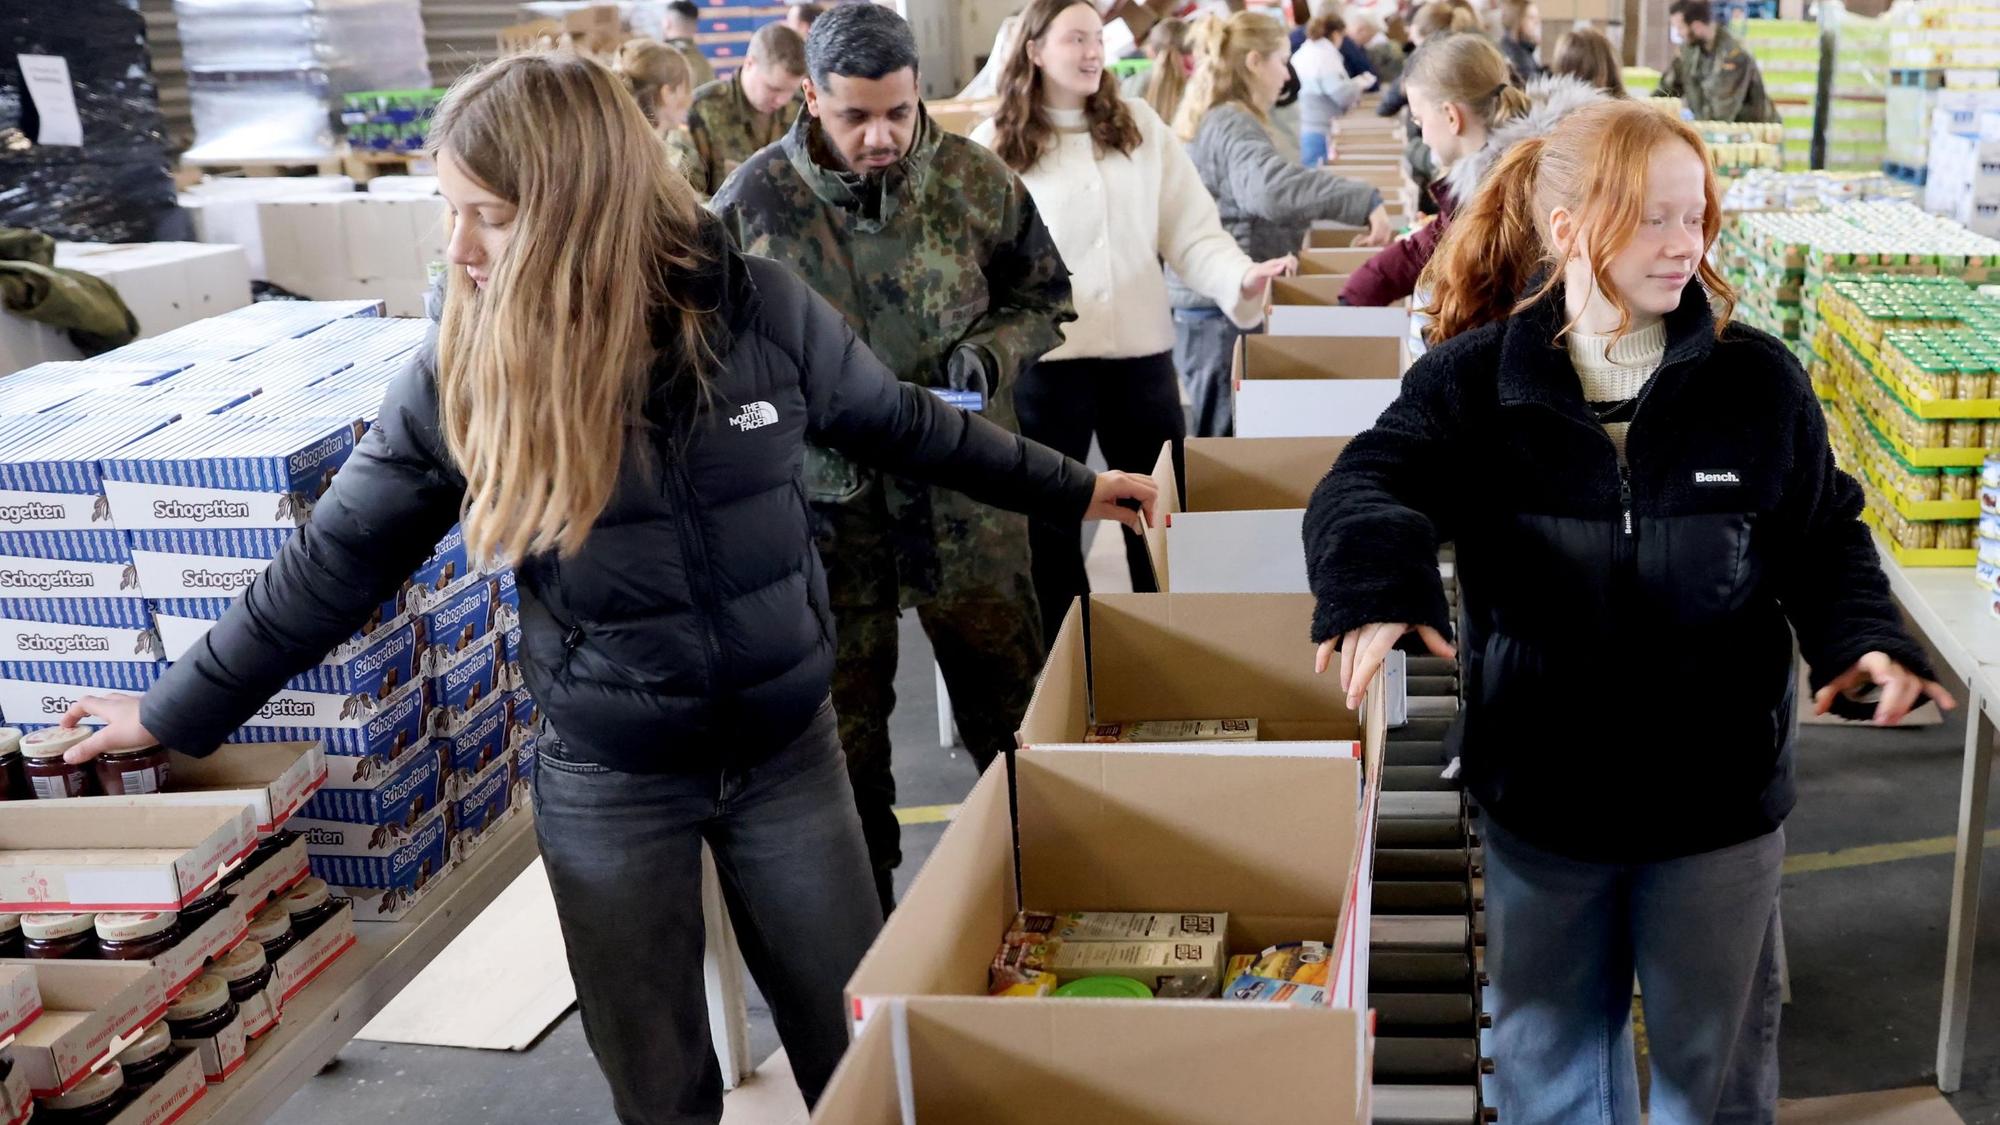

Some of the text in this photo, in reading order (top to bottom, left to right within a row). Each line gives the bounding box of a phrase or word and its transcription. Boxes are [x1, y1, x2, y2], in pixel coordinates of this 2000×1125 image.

[729, 410, 761, 426] NORTH
[740, 402, 760, 414] THE
[740, 419, 765, 432] FACE
[289, 436, 343, 474] Schogetten
[1695, 472, 1740, 483] Bench.
[0, 502, 65, 524] ogetten
[153, 500, 249, 522] Schogetten
[428, 532, 461, 562] getten
[0, 569, 94, 591] Schogetten
[182, 568, 260, 591] Schogett
[434, 593, 481, 631] Schogetten
[17, 633, 109, 654] Schogetten
[354, 636, 405, 679] Schogetten
[446, 651, 487, 690] Schogetten
[256, 699, 315, 719] getten
[368, 697, 414, 741] Schogetten
[456, 714, 498, 755] Schogetten
[382, 763, 430, 809] Schogetten
[463, 774, 501, 816] Schogetten
[304, 828, 344, 845] etten
[393, 826, 437, 873] Schogetten
